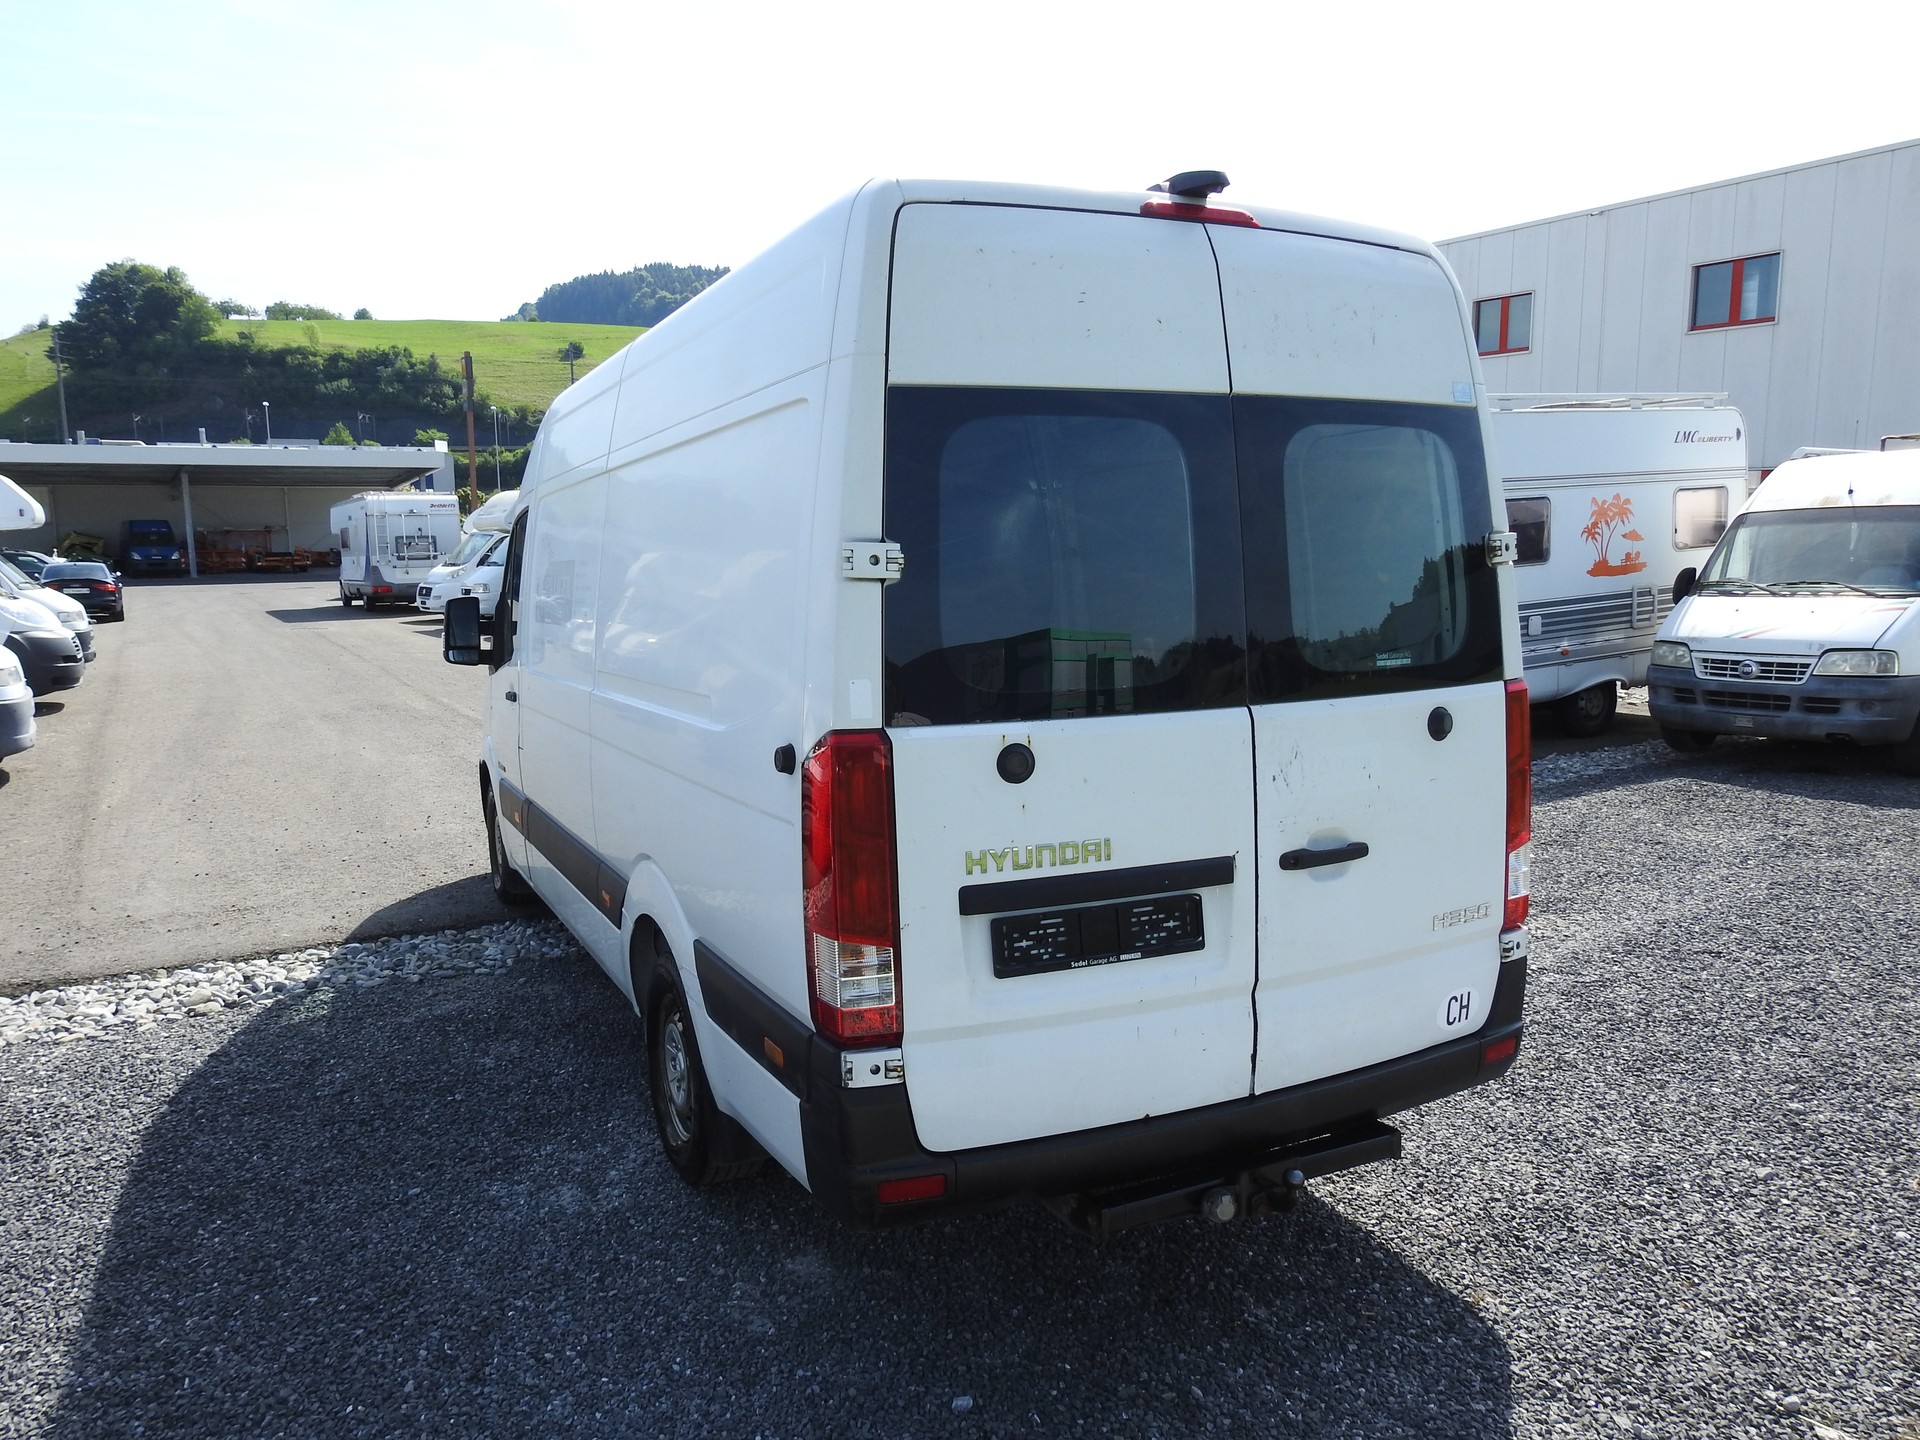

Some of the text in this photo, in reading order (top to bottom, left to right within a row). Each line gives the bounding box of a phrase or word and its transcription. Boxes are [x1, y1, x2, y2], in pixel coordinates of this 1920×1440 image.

[1674, 430, 1699, 444] LMC
[965, 837, 1112, 875] HYUNDAI
[1432, 902, 1491, 932] H350
[1071, 959, 1088, 968] Sedel
[1089, 957, 1108, 966] Garage
[1446, 991, 1471, 1026] CH
